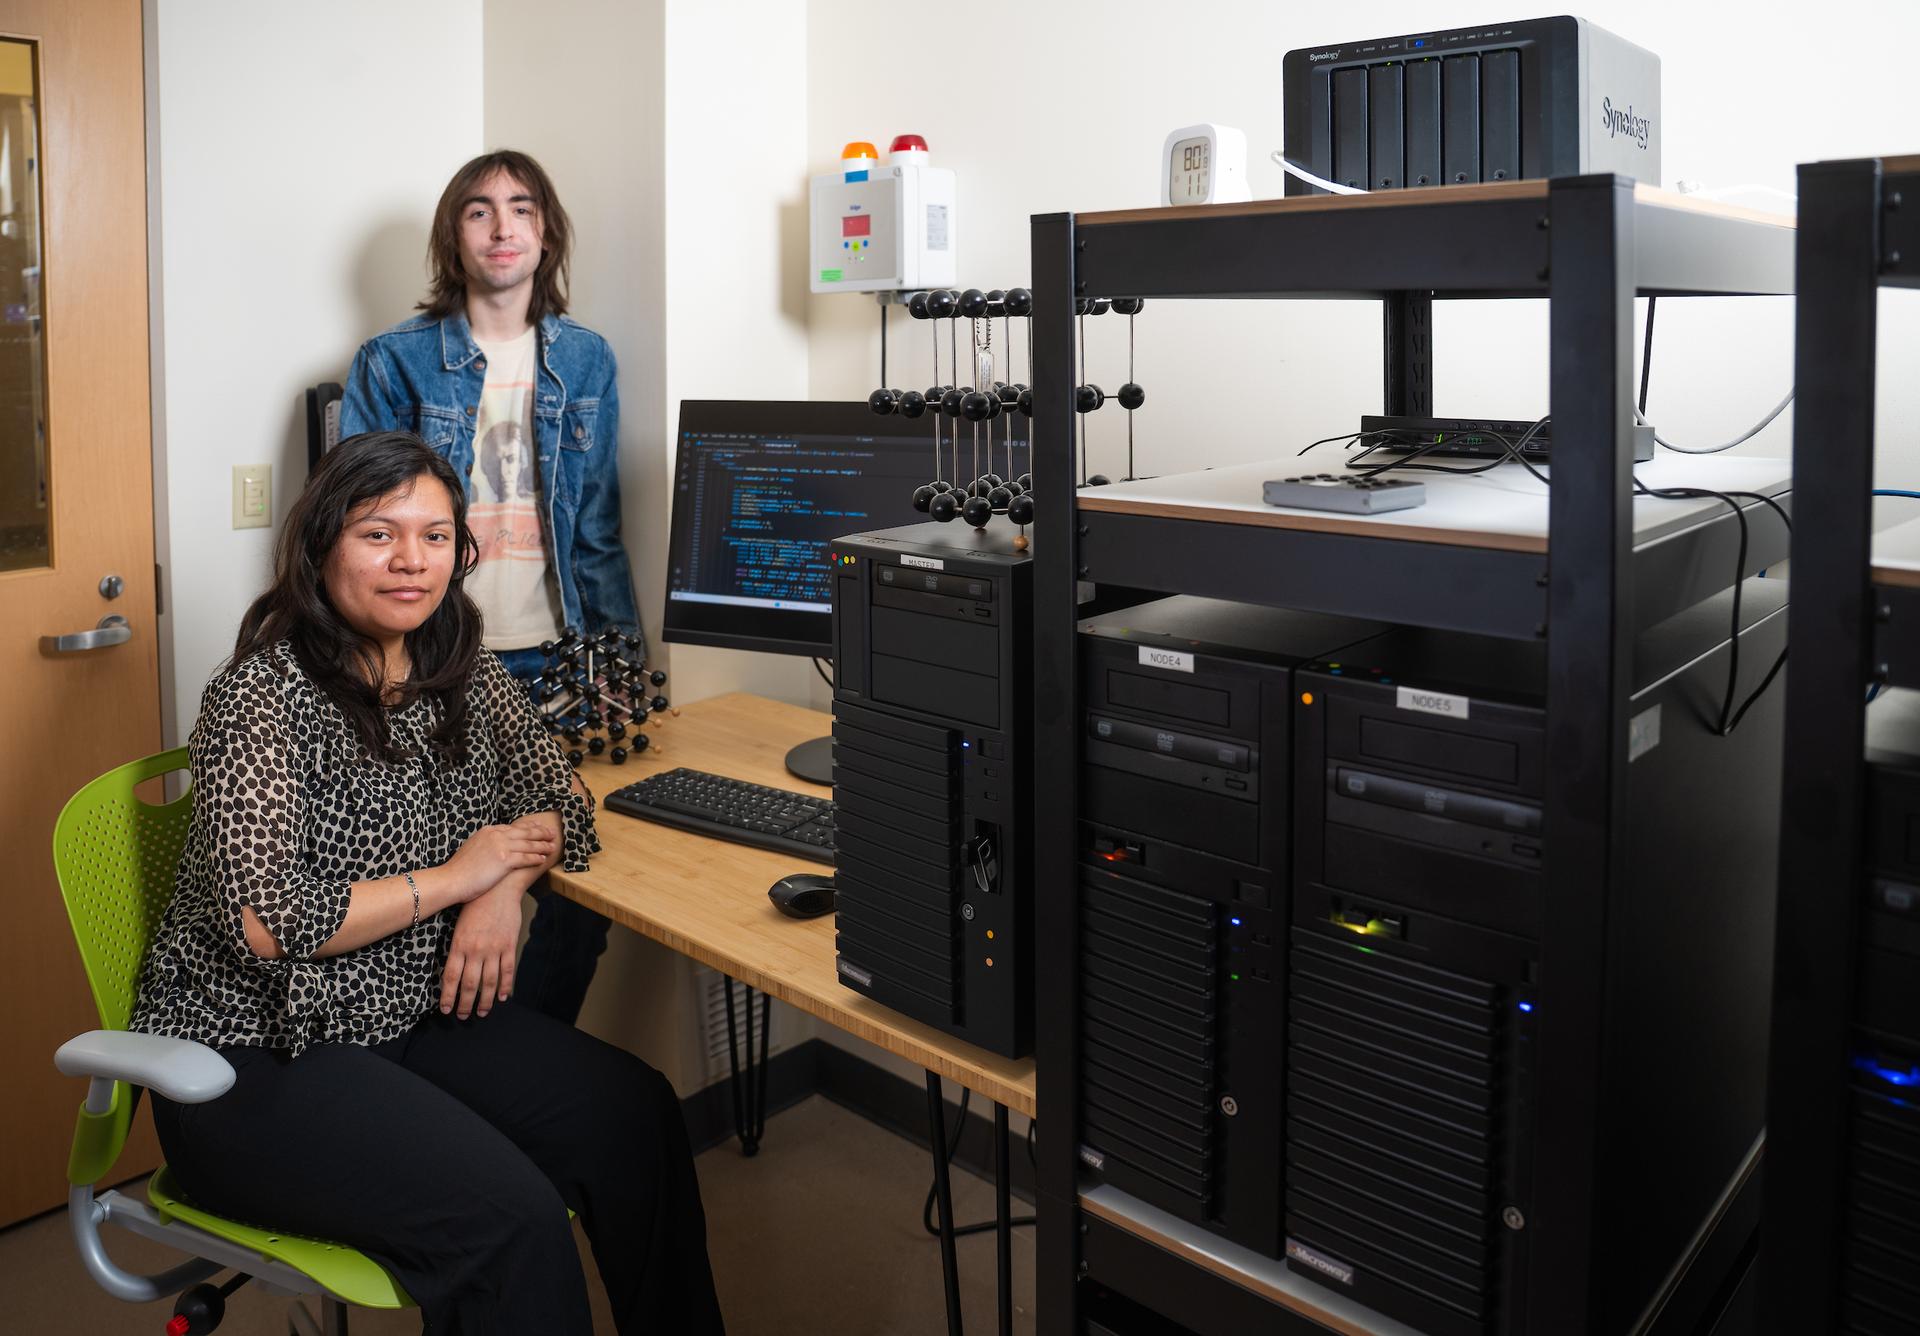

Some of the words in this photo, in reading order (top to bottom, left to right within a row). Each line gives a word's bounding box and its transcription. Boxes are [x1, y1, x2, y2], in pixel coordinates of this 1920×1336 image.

[1309, 50, 1340, 62] Synology
[1602, 96, 1650, 150] Synology
[1184, 145, 1201, 171] 80
[908, 559, 936, 569] MASTER
[1150, 652, 1181, 667] NODE4
[1412, 694, 1452, 712] NODE5
[1296, 1247, 1351, 1282] Microway
